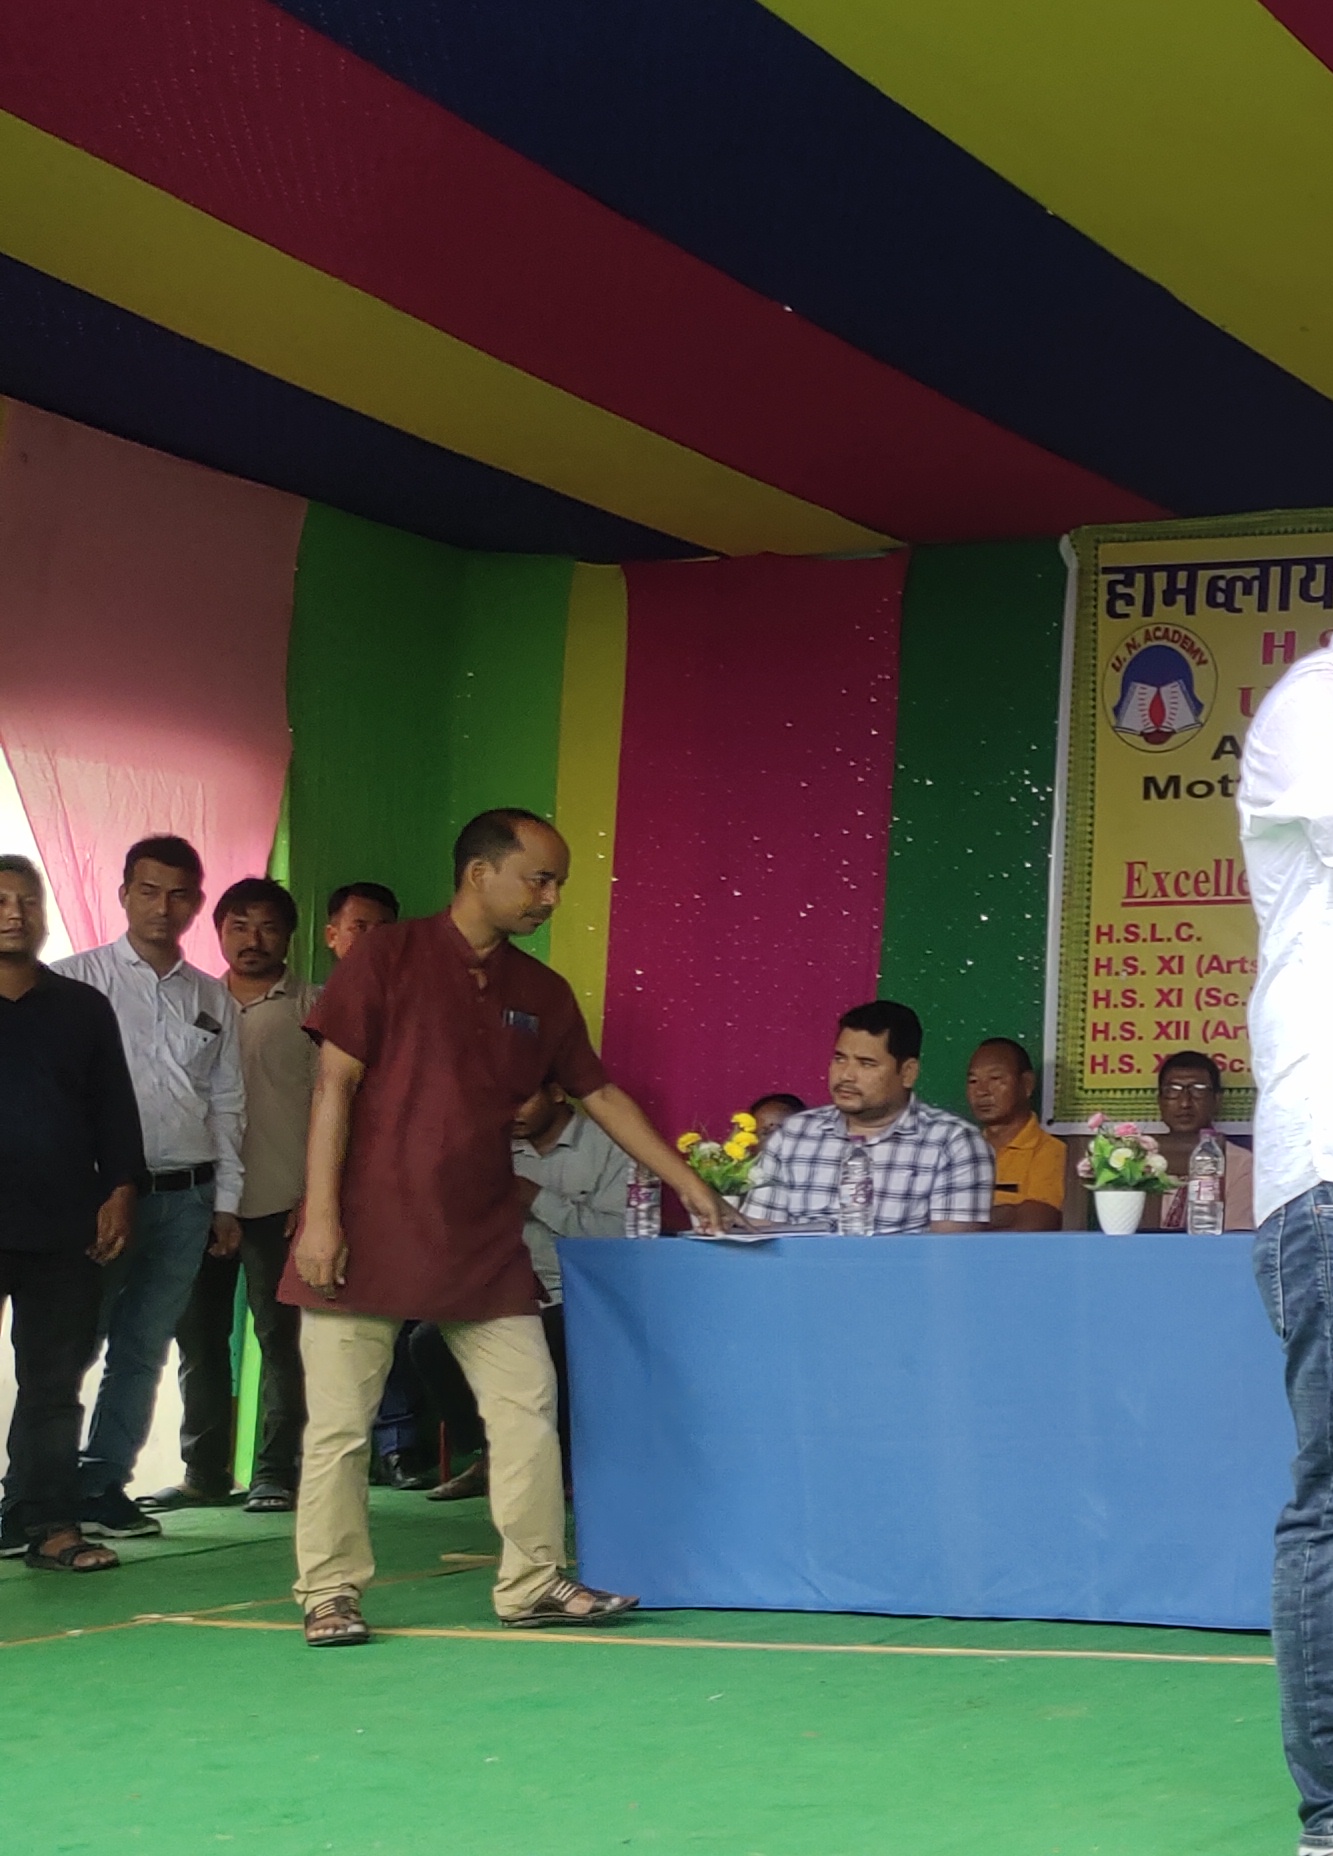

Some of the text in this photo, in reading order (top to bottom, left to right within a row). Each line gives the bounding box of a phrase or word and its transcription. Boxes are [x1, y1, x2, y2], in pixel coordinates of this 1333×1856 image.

[1143, 626, 1209, 667] ACADEMY
[1122, 858, 1250, 900] Excelle
[1095, 922, 1203, 945] H.S.L.C.
[1093, 954, 1259, 979] H.S. XI (Arts
[1092, 987, 1250, 1012] H.S. XI (Sc.
[1091, 1020, 1250, 1045] H.S. XII (Ar
[1089, 1054, 1143, 1075] H.S.
